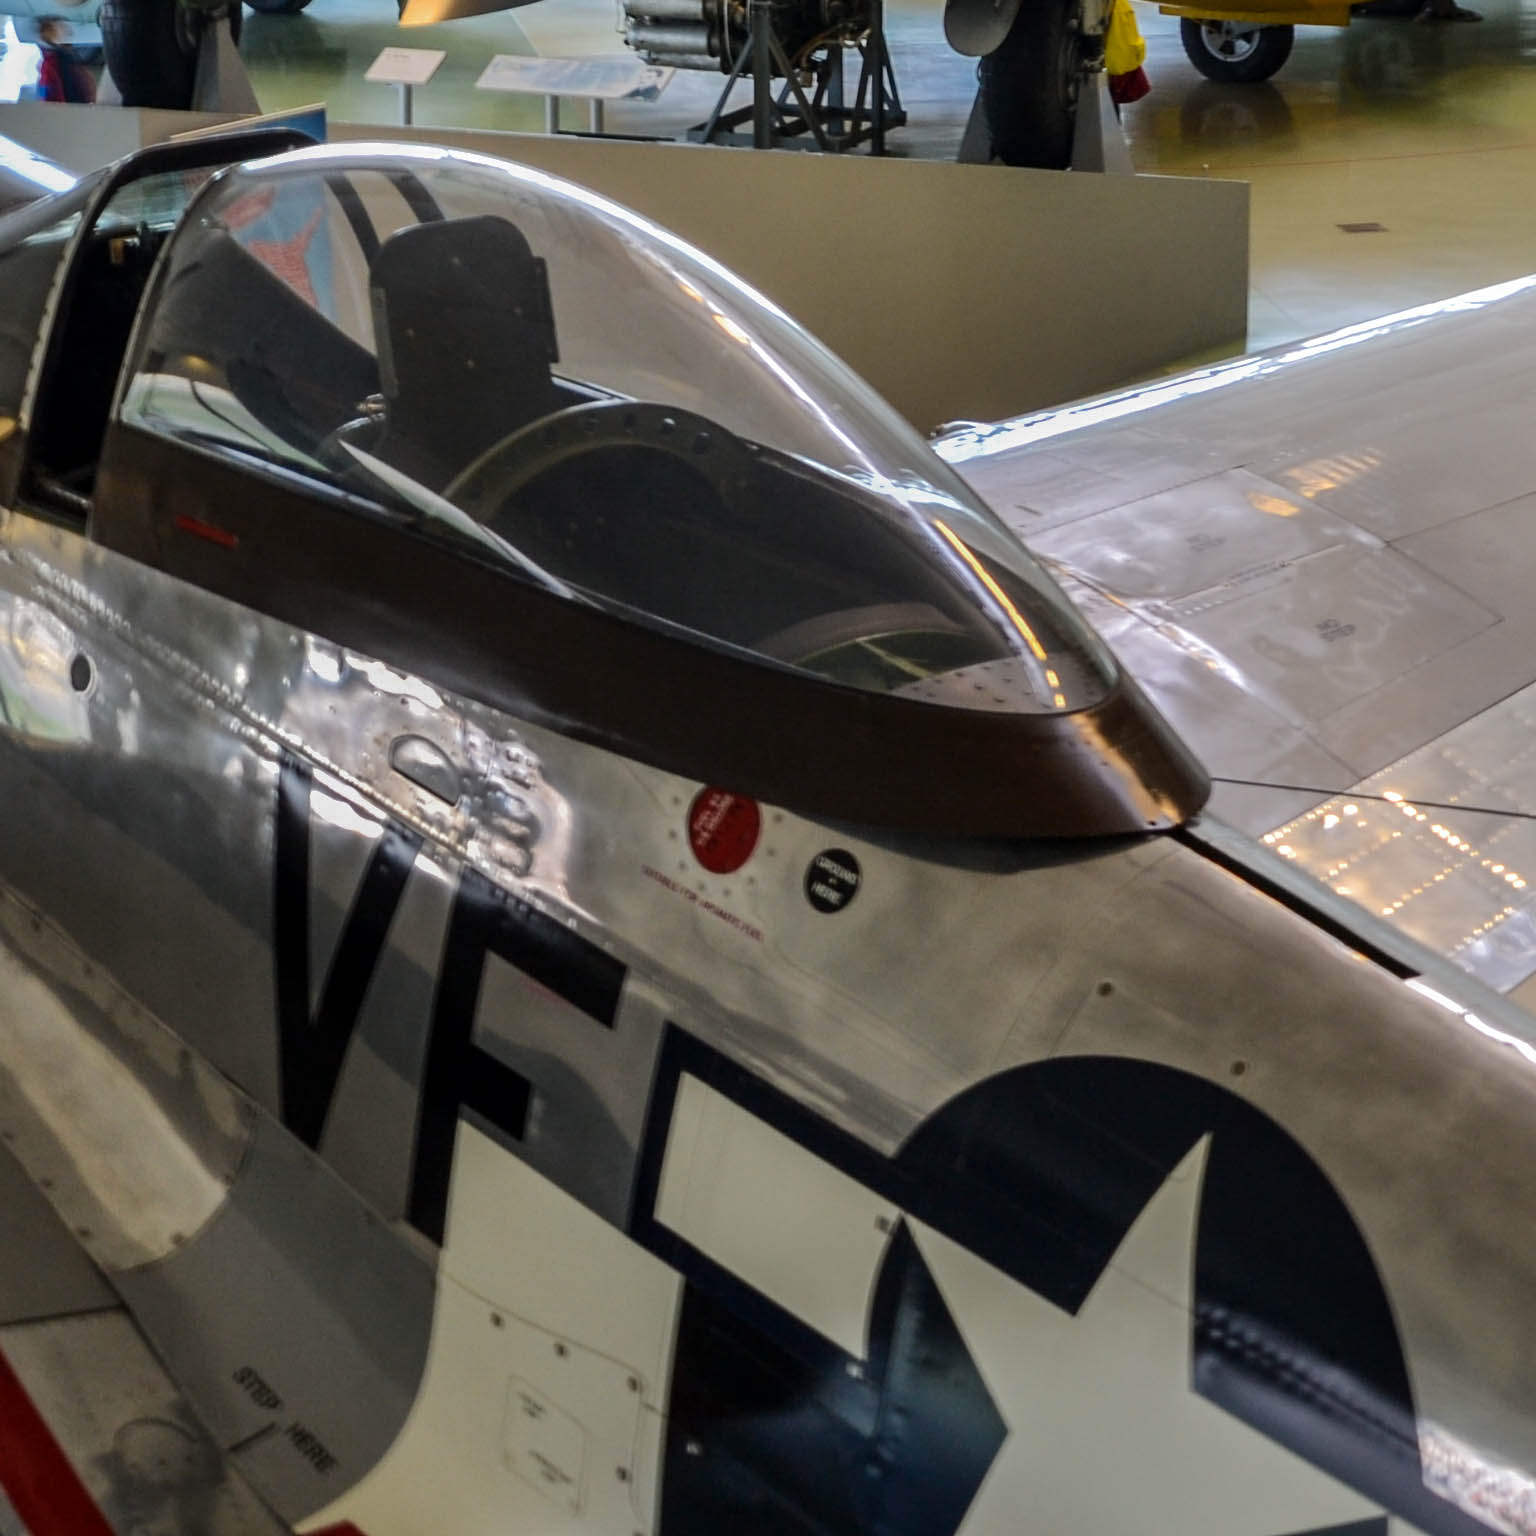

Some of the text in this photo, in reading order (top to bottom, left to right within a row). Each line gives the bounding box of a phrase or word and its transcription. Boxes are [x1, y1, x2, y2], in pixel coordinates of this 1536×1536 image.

[275, 747, 628, 1248] VF
[232, 1366, 284, 1408] STEP
[286, 1422, 340, 1473] HERE
